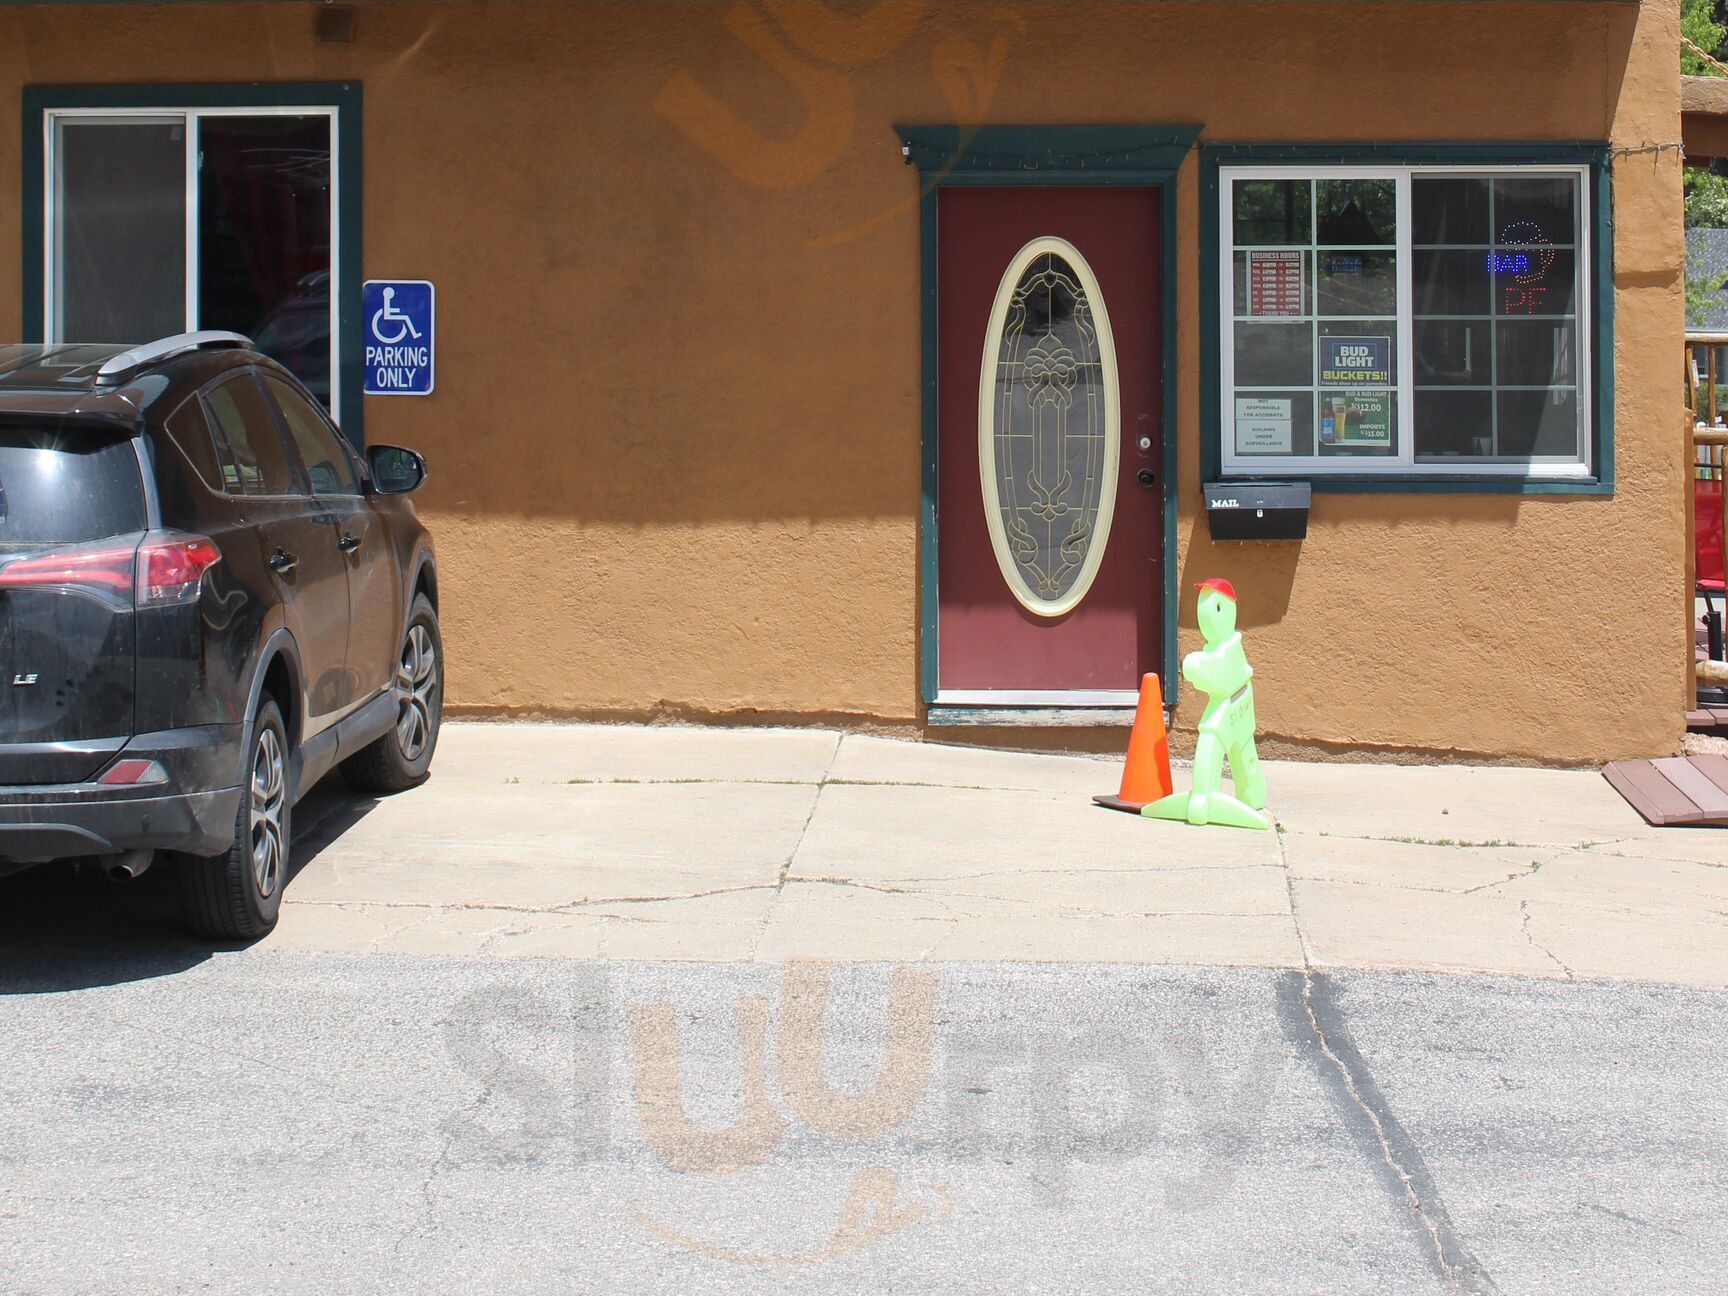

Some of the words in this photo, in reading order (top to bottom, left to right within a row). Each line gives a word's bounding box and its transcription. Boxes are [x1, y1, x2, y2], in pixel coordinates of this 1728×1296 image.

[1487, 254, 1528, 273] BAR
[366, 346, 428, 367] PARKING
[1340, 346, 1369, 357] BUD
[1334, 356, 1375, 367] LIGHT
[376, 367, 417, 388] ONLY
[1323, 370, 1388, 381] BUCKETS!!
[1211, 499, 1239, 508] MAIL
[13, 673, 39, 685] LE
